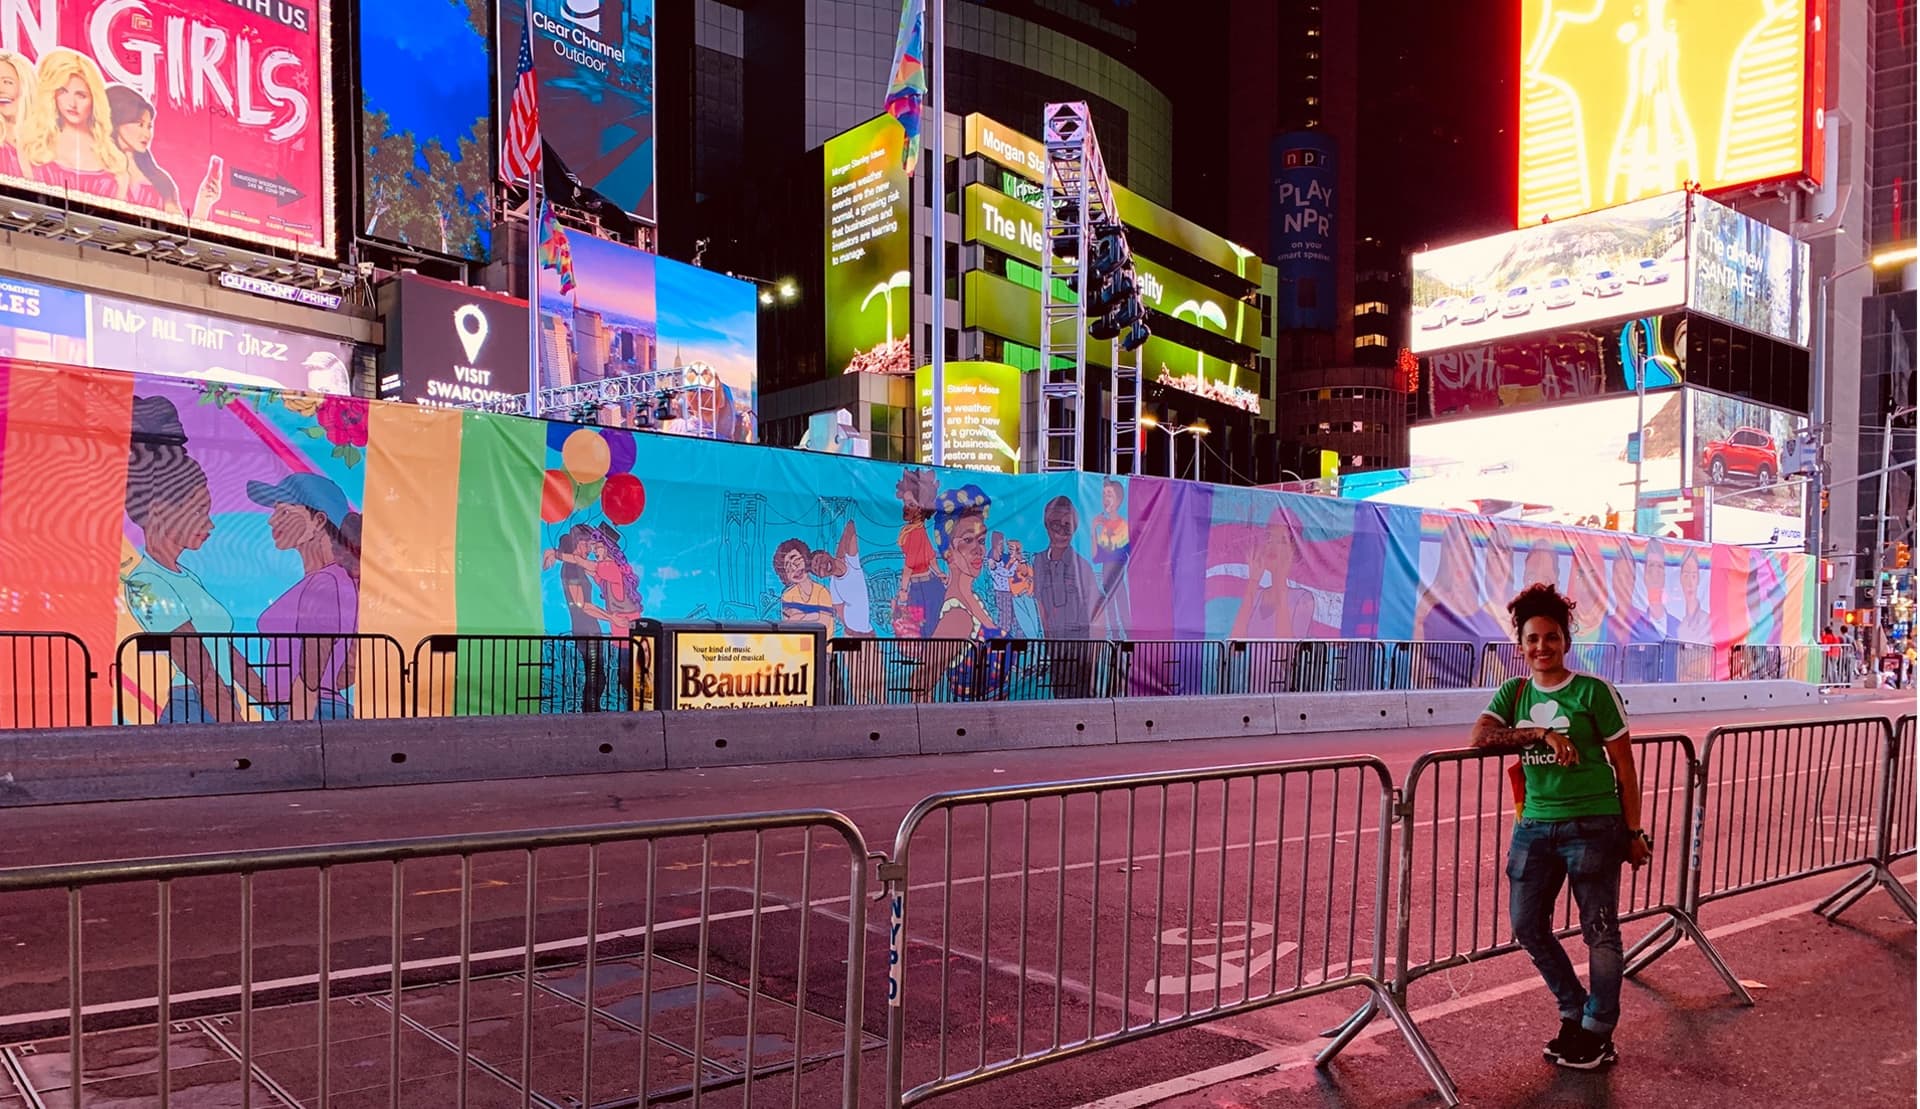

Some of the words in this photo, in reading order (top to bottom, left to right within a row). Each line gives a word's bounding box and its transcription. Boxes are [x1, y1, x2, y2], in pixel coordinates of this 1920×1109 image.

[278, 1, 308, 32] US.
[533, 12, 570, 39] Clear
[572, 28, 625, 62] Channel
[554, 40, 606, 72] Outdoor
[90, 0, 308, 141] GIRLS
[984, 128, 1024, 164] Morgan
[1287, 152, 1327, 166] npr
[832, 183, 857, 198] Extreme
[858, 170, 883, 187] weather
[832, 196, 852, 211] events
[853, 193, 863, 202] are
[865, 187, 875, 199] the
[876, 182, 890, 194] new
[861, 198, 887, 216] growing
[888, 191, 900, 203] risk
[832, 225, 844, 238] that
[880, 207, 893, 220] and
[860, 232, 871, 242] are
[872, 221, 898, 238] learning
[983, 202, 1016, 240] The
[1703, 229, 1724, 256] The
[832, 256, 839, 265] to
[1699, 256, 1738, 289] SANTA
[0, 283, 39, 297] OMINEE
[303, 292, 338, 306] PRIME
[103, 307, 146, 333] AND
[152, 317, 184, 343] ALL
[184, 322, 233, 350] THAT
[237, 333, 289, 361] JAZZ
[454, 365, 491, 386] VISIT
[947, 384, 977, 395] Stanley
[979, 384, 1000, 394] Ideas
[947, 417, 961, 425] are
[965, 416, 979, 424] the
[982, 418, 1000, 426] new
[955, 403, 992, 413] weather
[680, 663, 808, 698] Beautiful
[889, 896, 902, 1000] NYPD
